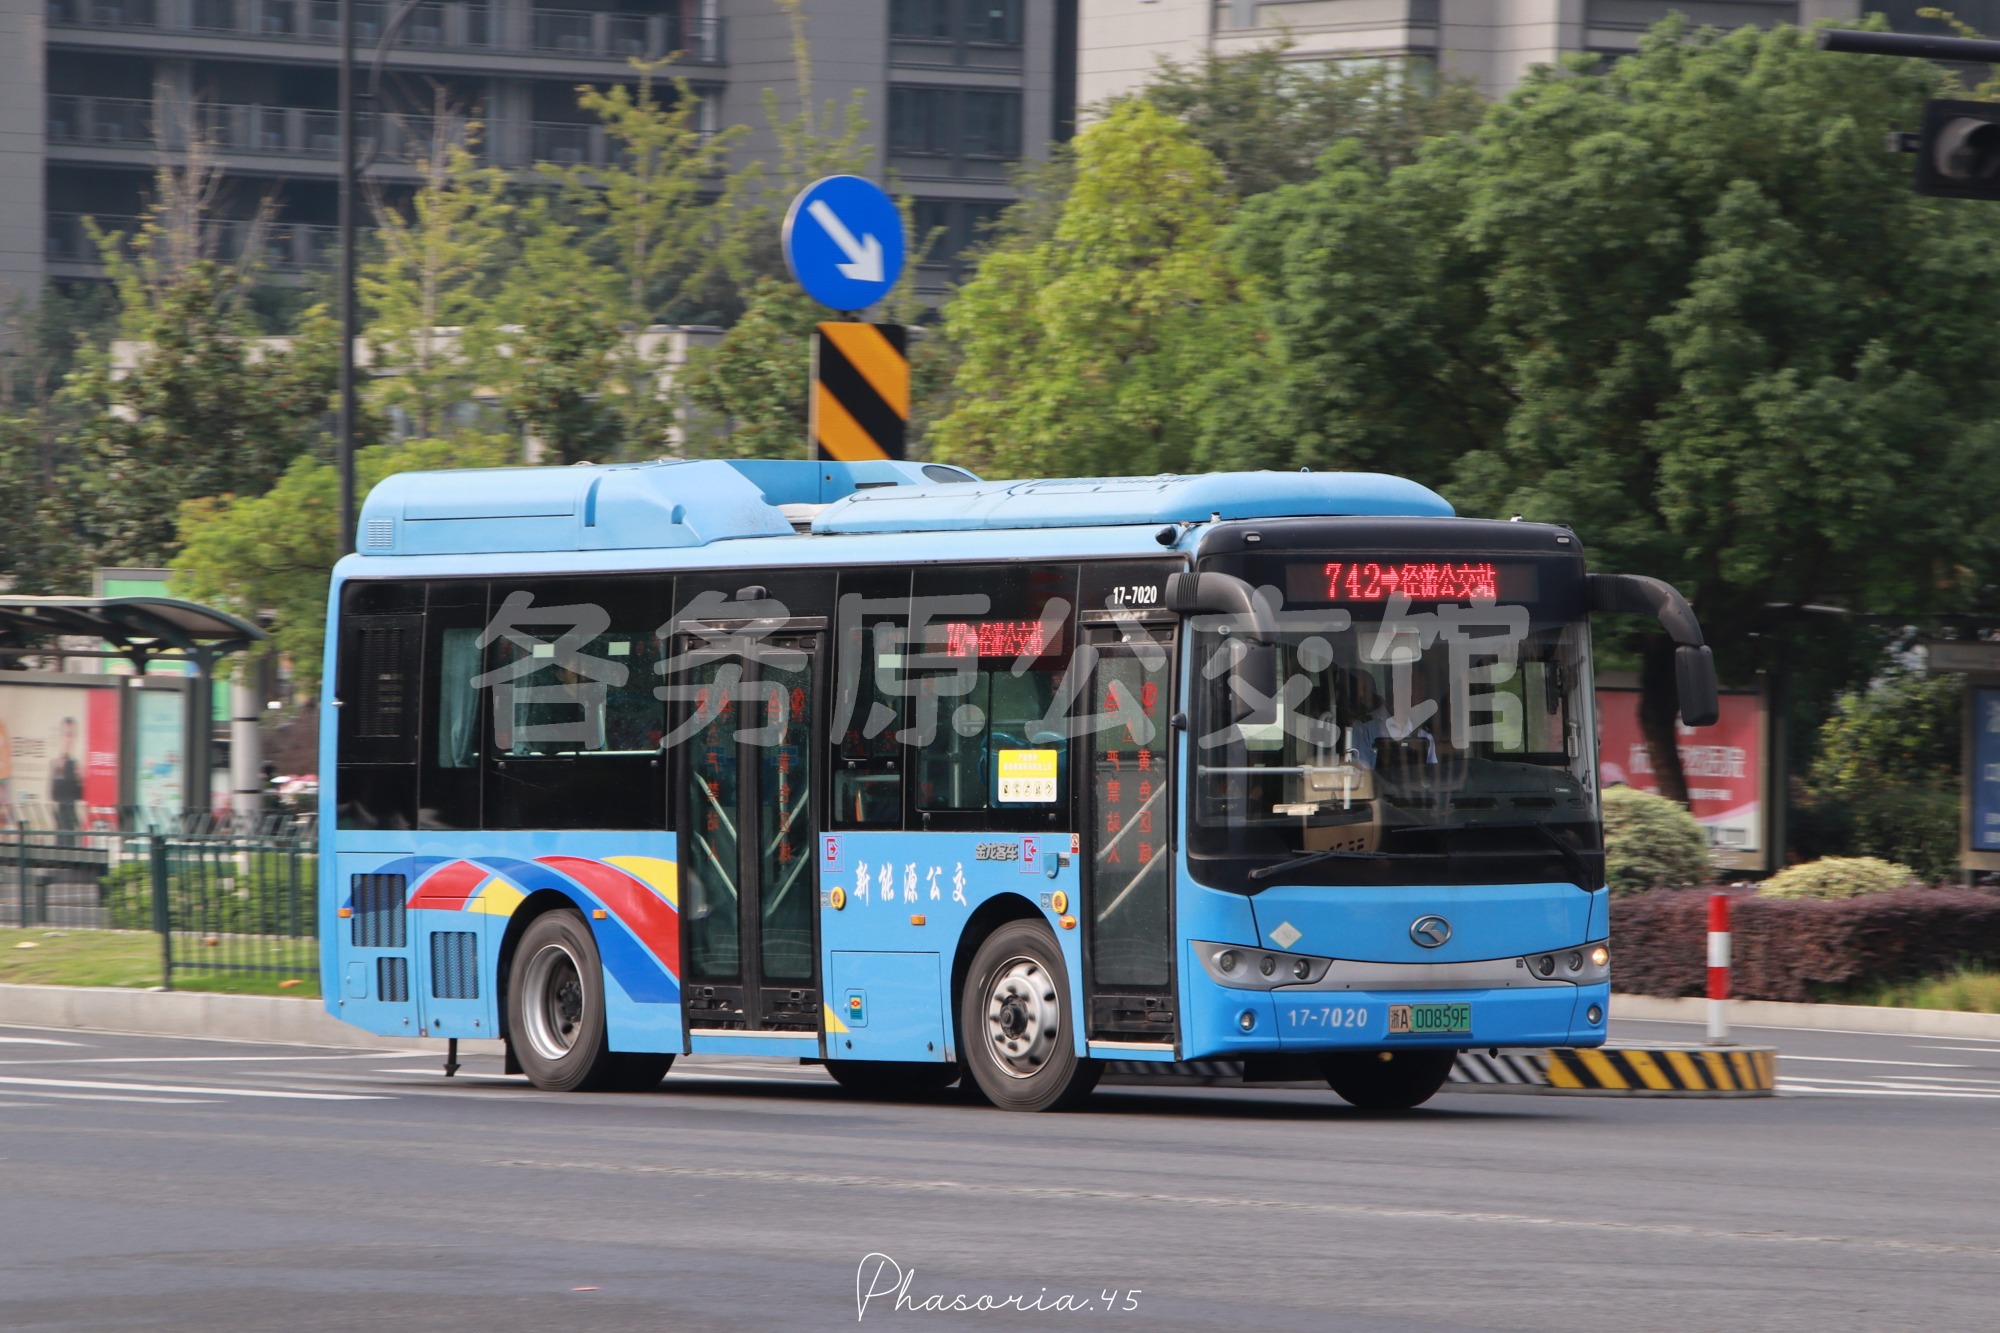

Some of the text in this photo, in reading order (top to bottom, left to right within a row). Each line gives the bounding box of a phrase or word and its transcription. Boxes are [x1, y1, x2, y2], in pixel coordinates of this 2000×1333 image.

[1326, 563, 1381, 598] 742
[1113, 586, 1158, 605] 17-7020
[976, 842, 1019, 861] 金龙客车
[853, 860, 967, 907] 新能源公交
[1288, 1007, 1368, 1028] 17-7020
